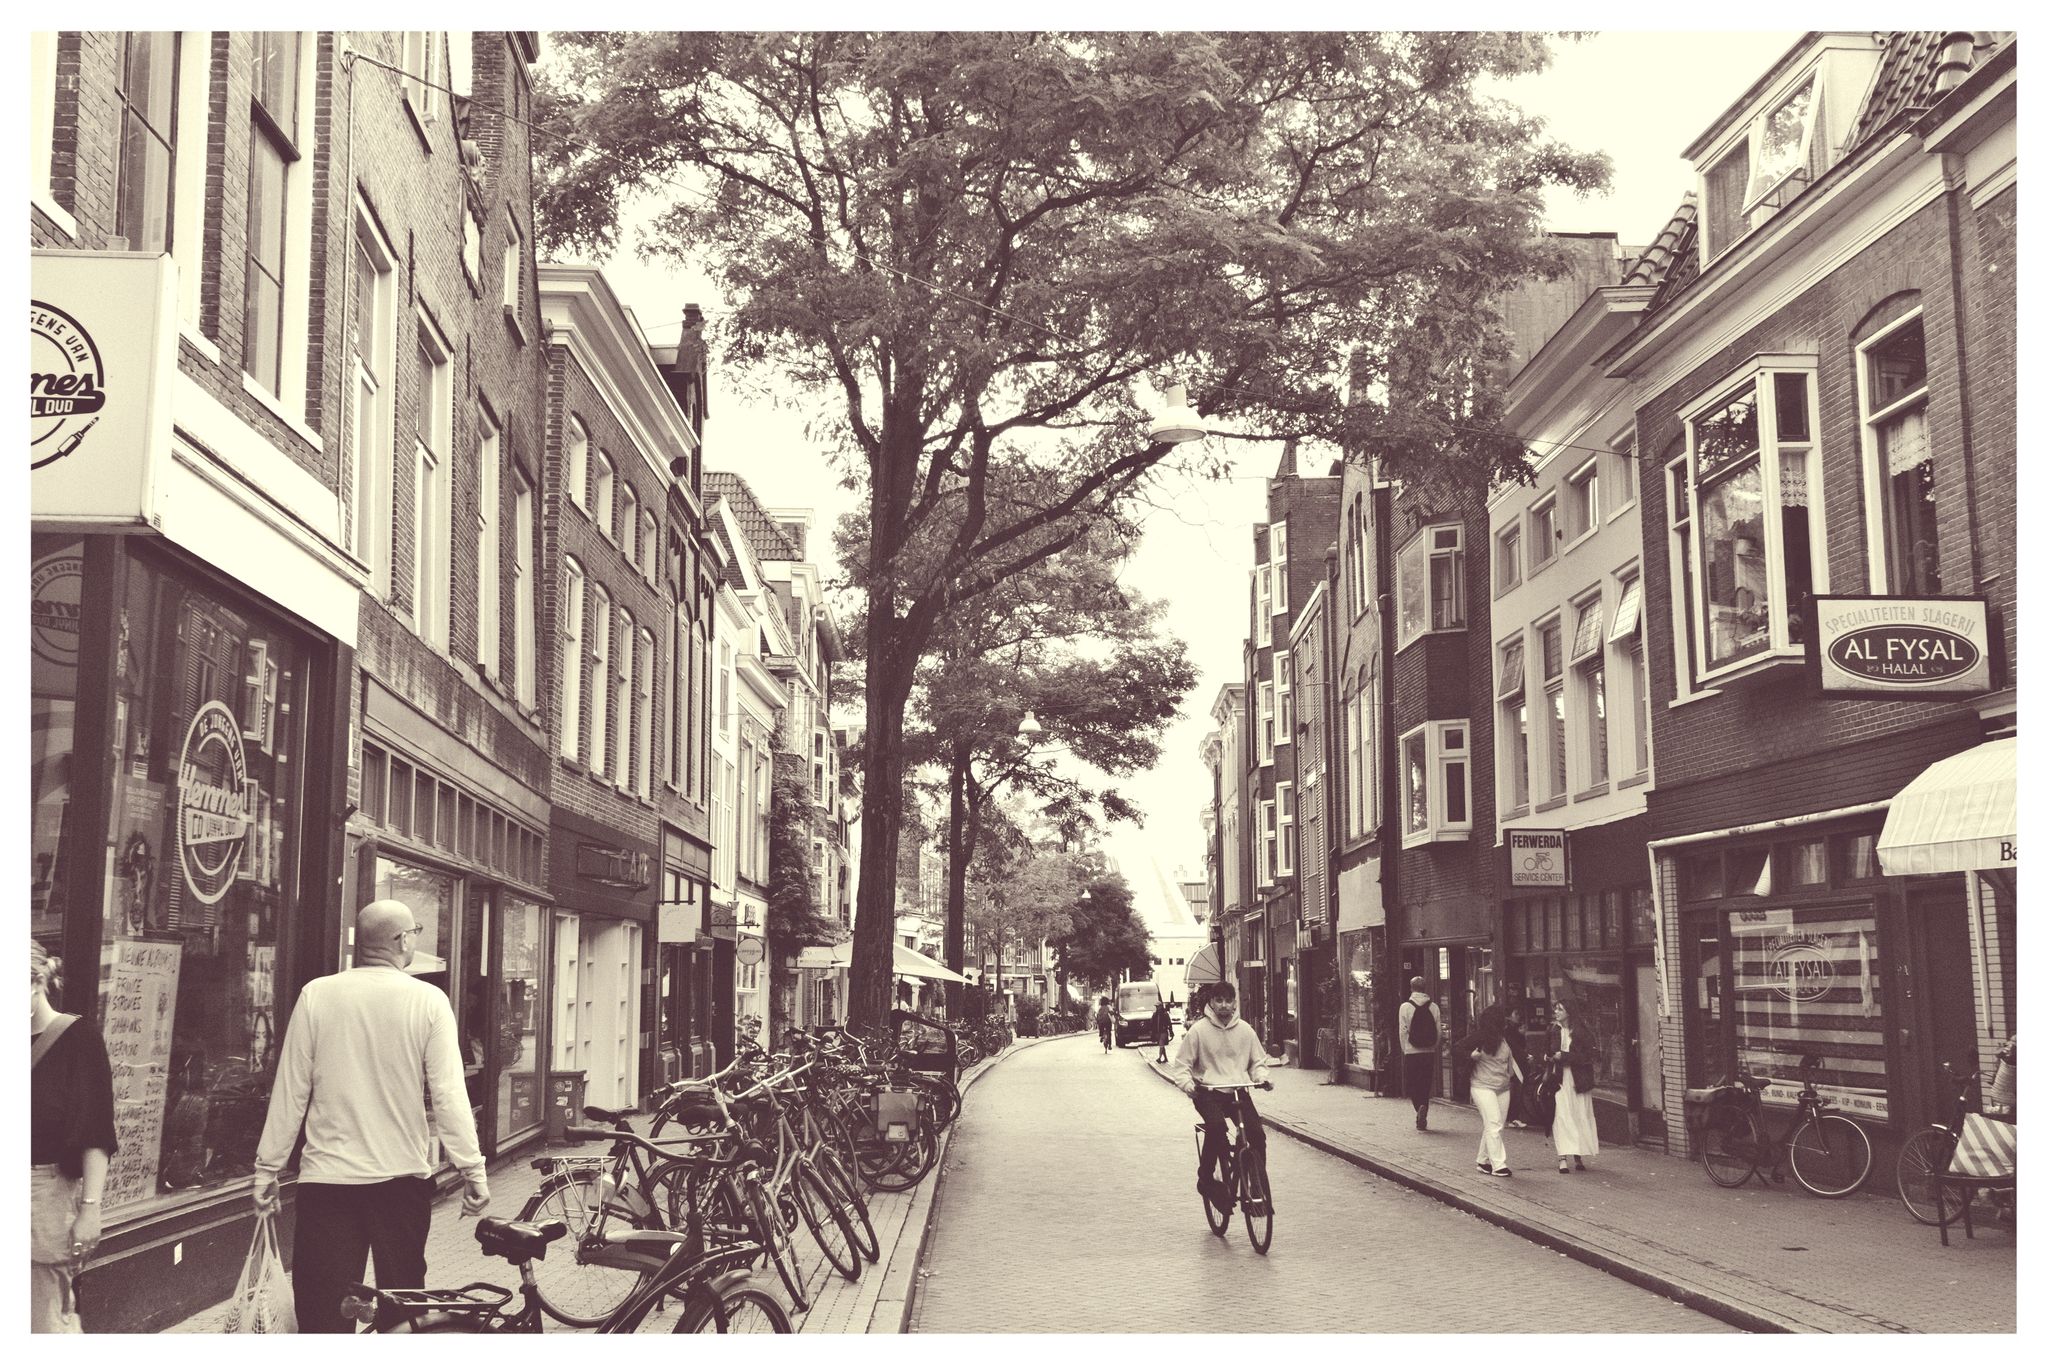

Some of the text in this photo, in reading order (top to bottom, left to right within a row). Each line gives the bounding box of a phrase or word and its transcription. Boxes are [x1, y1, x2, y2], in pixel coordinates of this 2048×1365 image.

[1825, 606, 1976, 636] SPECIALITEITEN SLAGERIJ
[1845, 638, 1963, 661] AL FYSAL
[1882, 664, 1926, 675] HALAL
[1512, 835, 1562, 848] FERWERDA
[1514, 872, 1563, 881] SERVICE CENTER
[1776, 960, 1828, 980] AL FYSAL
